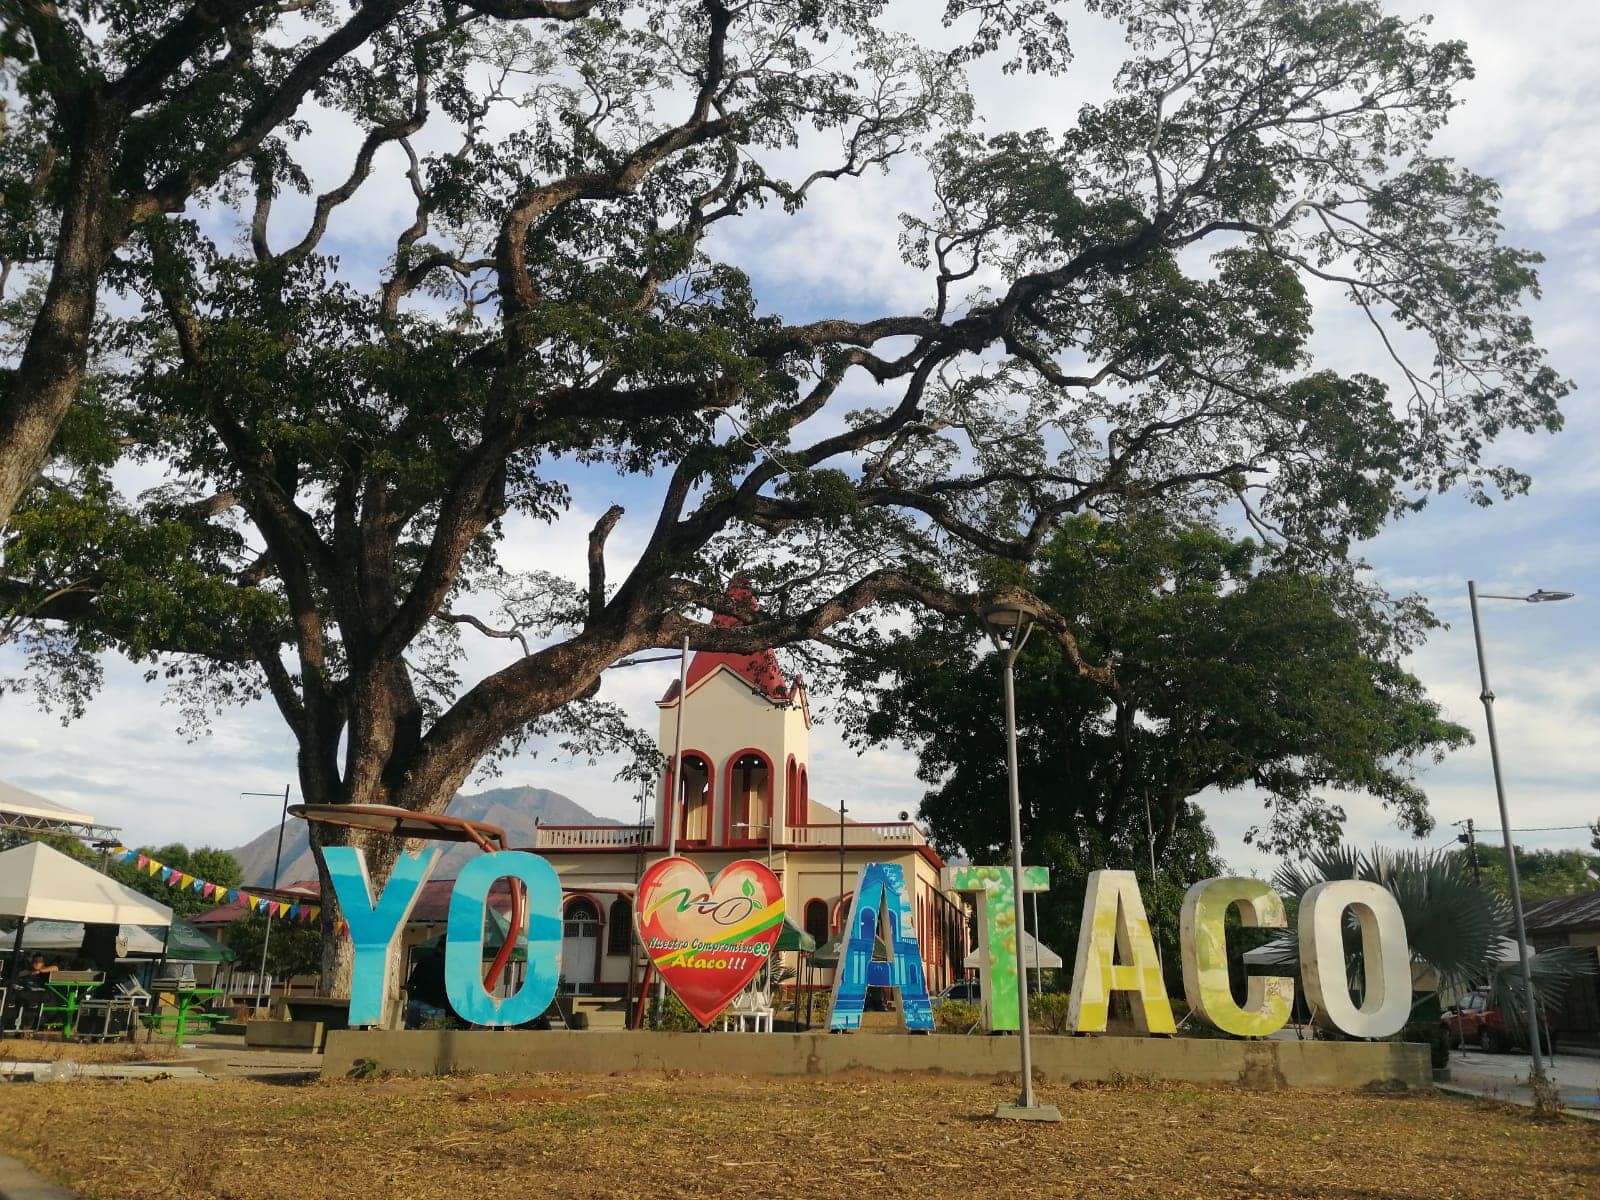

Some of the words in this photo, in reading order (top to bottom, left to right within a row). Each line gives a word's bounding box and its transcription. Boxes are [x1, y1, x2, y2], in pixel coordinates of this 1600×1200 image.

[321, 846, 563, 1026] YO
[826, 862, 1413, 1039] ATACO
[648, 936, 689, 949] Nuestro
[691, 938, 754, 955] Compromiso
[753, 941, 770, 956] es
[670, 954, 747, 970] Ataco!!!
